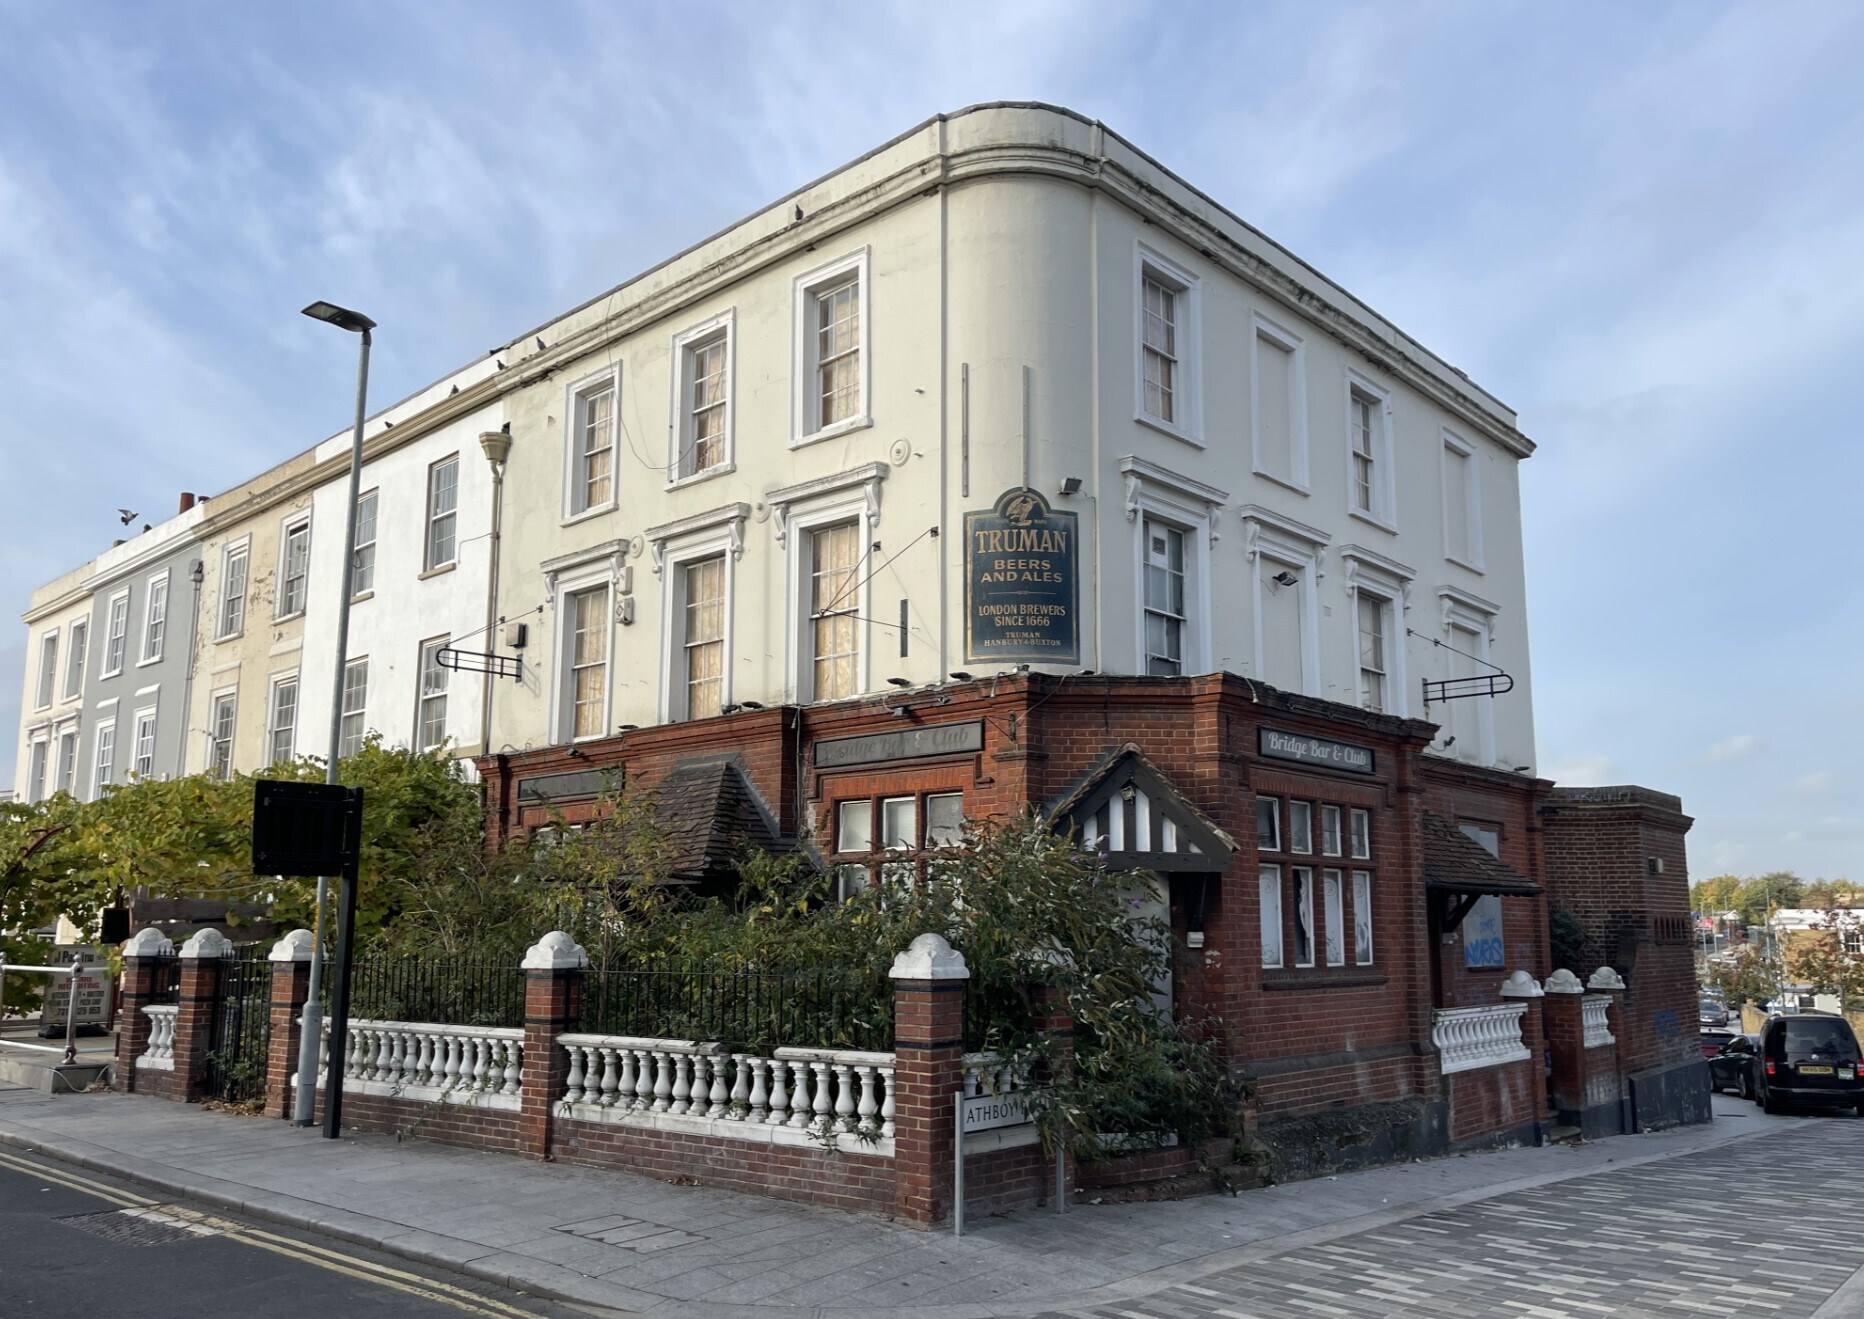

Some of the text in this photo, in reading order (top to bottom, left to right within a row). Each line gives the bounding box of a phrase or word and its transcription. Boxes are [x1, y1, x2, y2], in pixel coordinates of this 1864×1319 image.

[975, 530, 1067, 553] TRUMAN
[994, 559, 1051, 570] BEERS
[981, 571, 1063, 583] AND ALES
[979, 604, 1066, 617] LONDON BREWERS
[994, 616, 1050, 627] SINCE 1666
[915, 731, 928, 749] &
[933, 728, 969, 746] Club
[1268, 732, 1366, 765] Bridge Bar & Club
[966, 1102, 1015, 1123] ATHBOY
